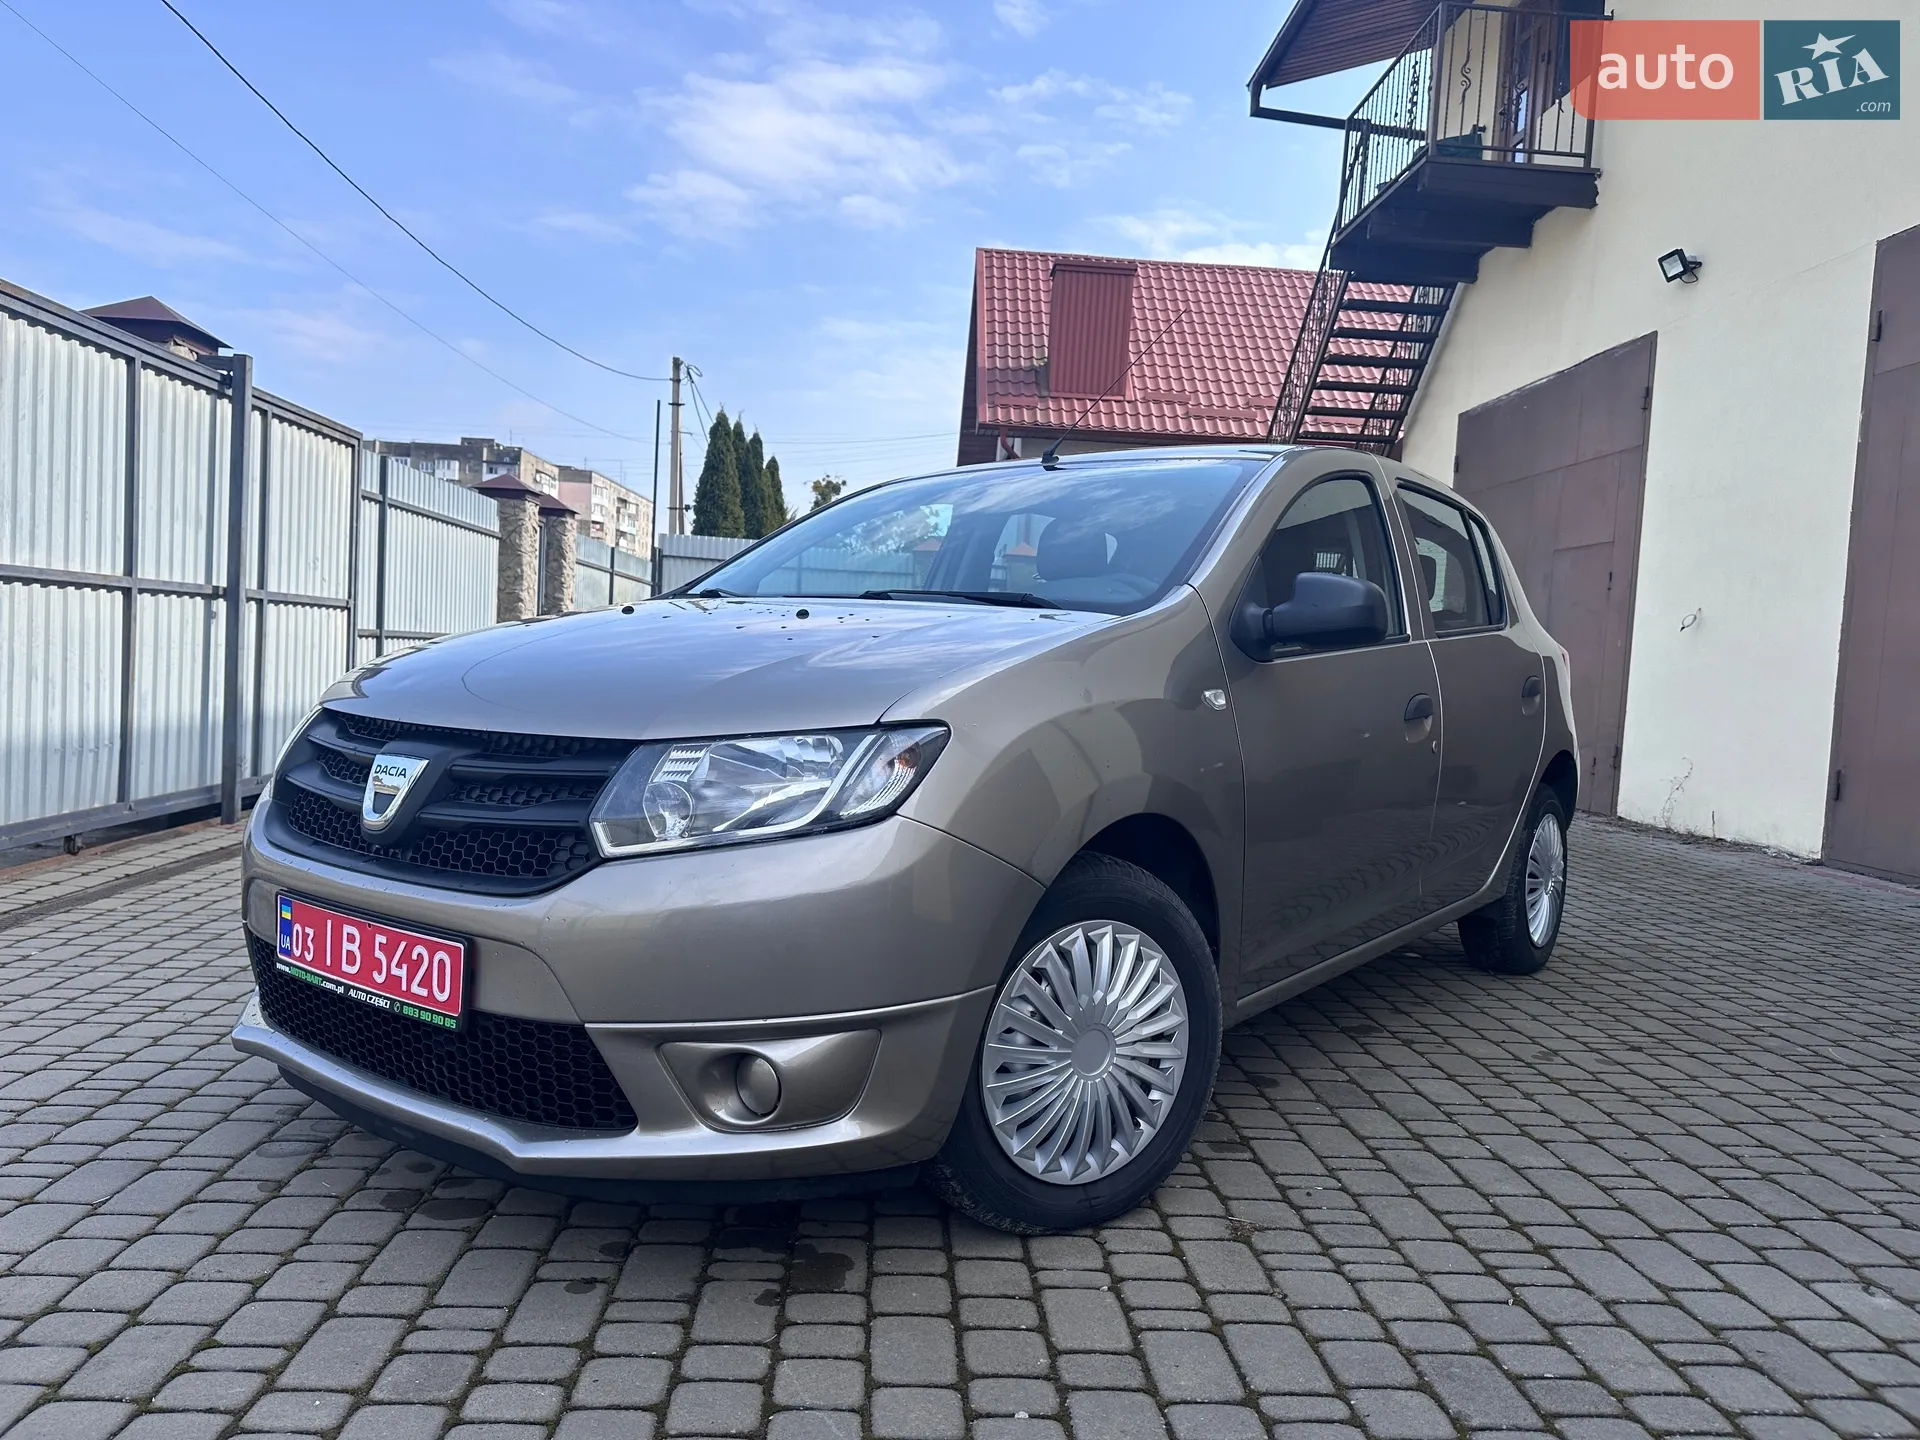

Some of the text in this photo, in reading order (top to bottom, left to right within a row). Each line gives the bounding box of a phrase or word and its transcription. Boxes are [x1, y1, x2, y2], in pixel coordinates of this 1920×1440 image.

[374, 764, 407, 778] DACIA
[280, 934, 291, 950] UA
[292, 919, 451, 1003] 03 IB 5420
[348, 988, 365, 1001] AUTO
[366, 995, 391, 1009] CZĘŚCI
[403, 1005, 419, 1018] 883
[420, 1010, 431, 1022] 90
[432, 1014, 444, 1025] 90
